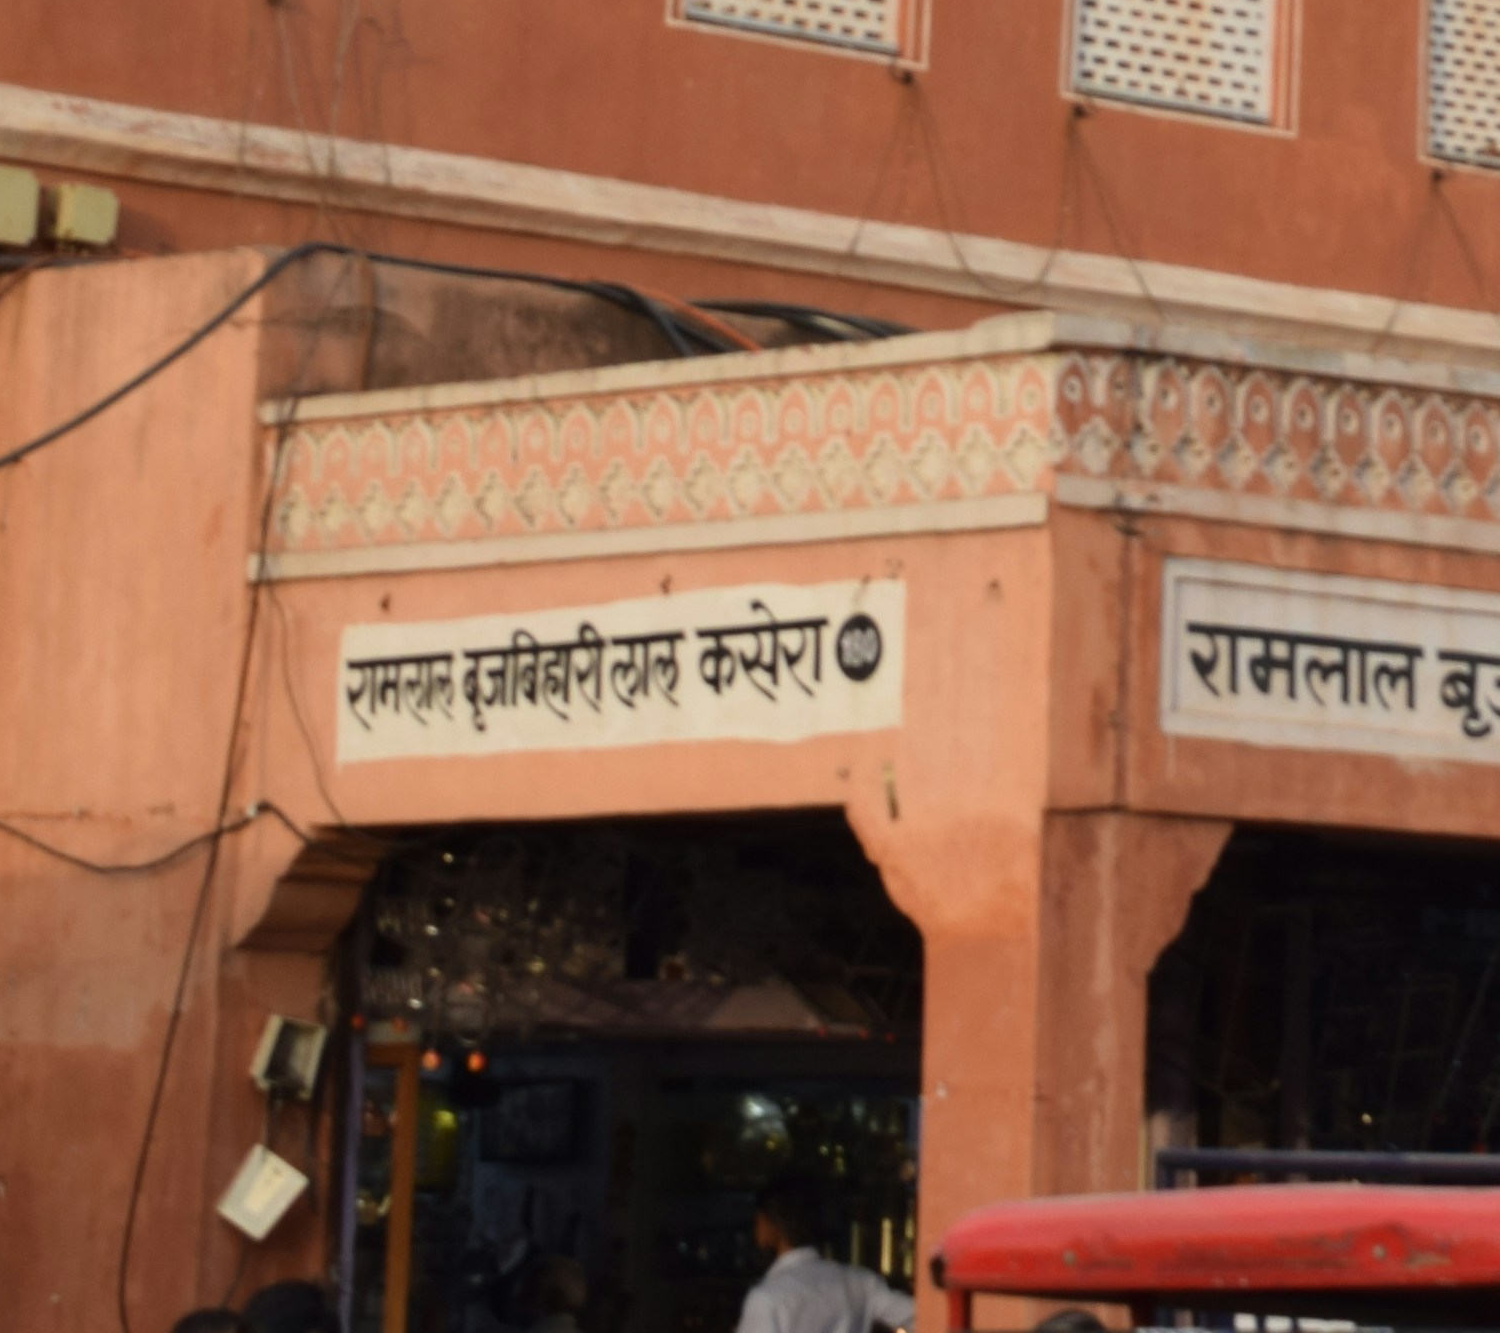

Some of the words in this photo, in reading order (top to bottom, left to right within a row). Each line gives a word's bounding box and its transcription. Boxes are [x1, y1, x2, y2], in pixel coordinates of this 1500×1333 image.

[347, 652, 456, 730] रामलाल
[608, 631, 685, 708] लाल
[696, 601, 829, 700] कसेरा
[1186, 622, 1424, 709] रामलाल
